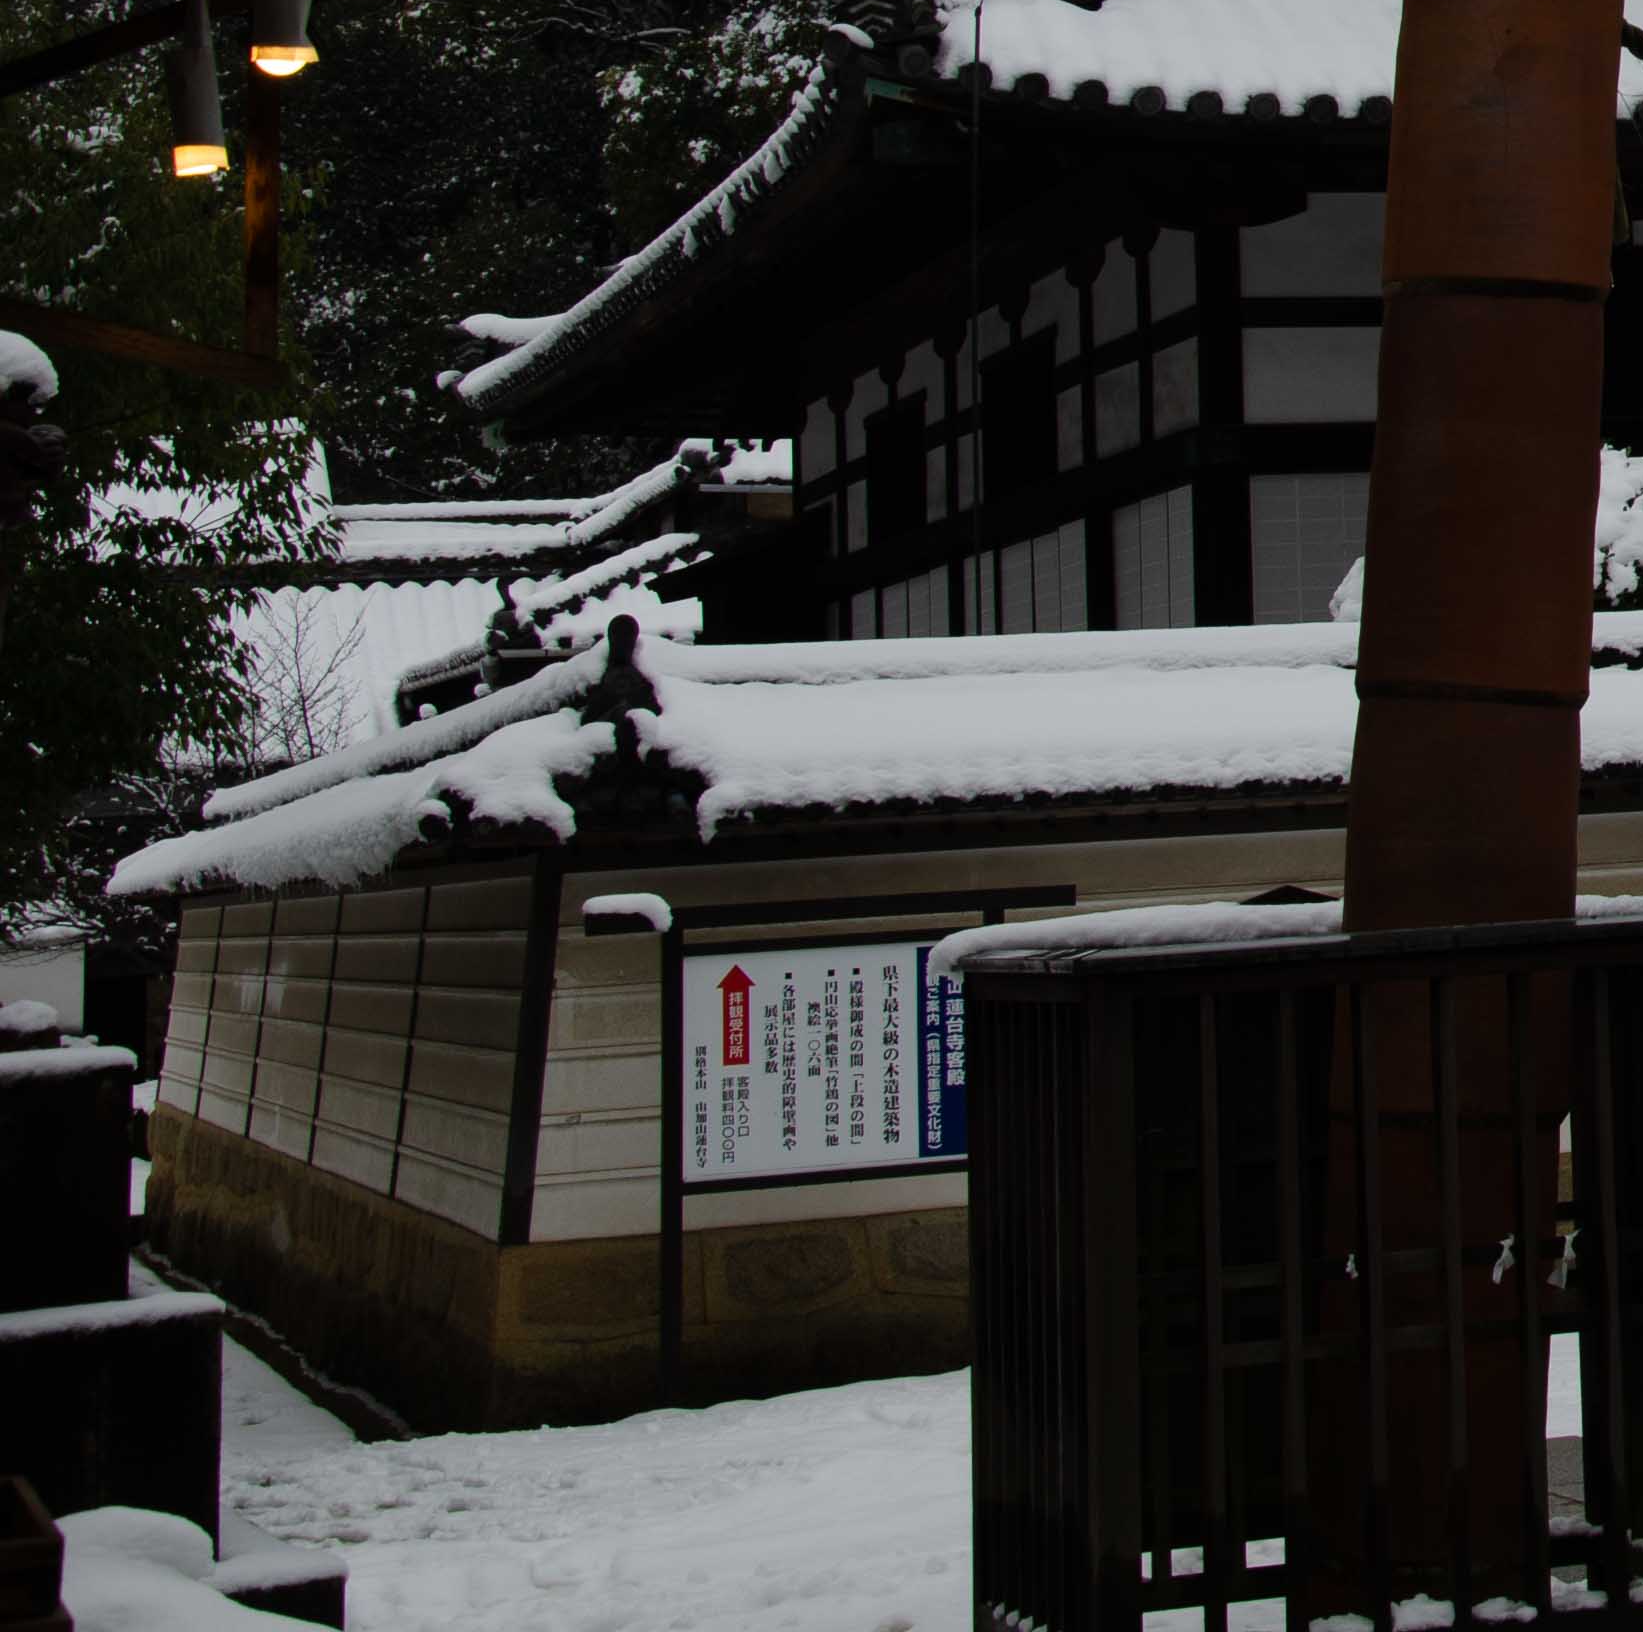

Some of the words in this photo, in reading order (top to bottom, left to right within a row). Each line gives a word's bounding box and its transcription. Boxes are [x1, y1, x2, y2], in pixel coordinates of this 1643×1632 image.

[728, 991, 745, 1059] 拝観受付所
[764, 1004, 778, 1074] 展示品多数
[883, 965, 900, 1144] 県下最大級の木造建築物
[782, 985, 797, 1151] 各部屋には歴史的障壁画や
[737, 1077, 750, 1137] 客殿入り口
